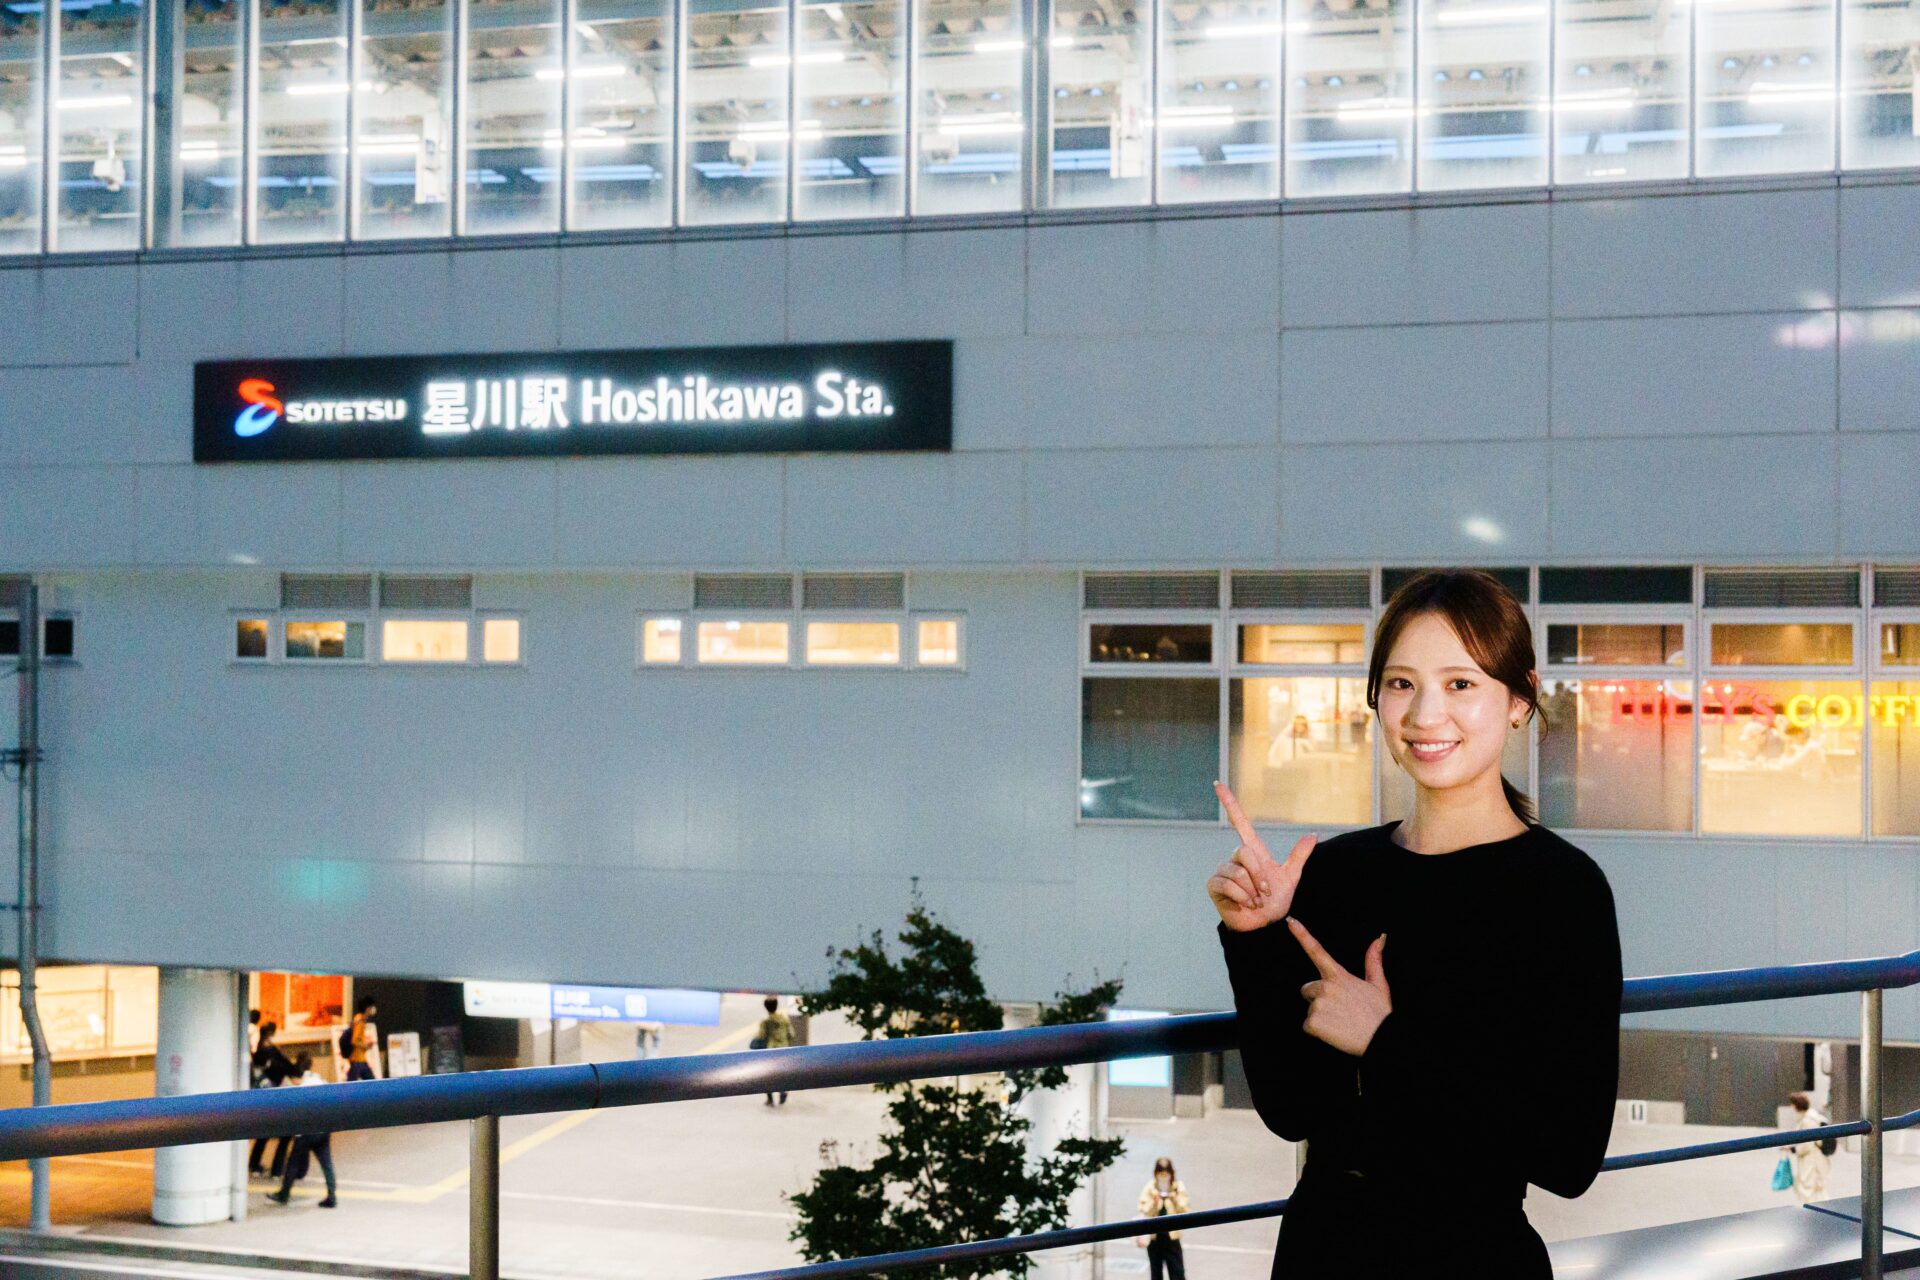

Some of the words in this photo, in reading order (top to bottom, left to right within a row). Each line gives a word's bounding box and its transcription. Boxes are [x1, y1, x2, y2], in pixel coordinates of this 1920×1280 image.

[285, 399, 406, 424] SOTETSU
[421, 377, 569, 435] 星川駅
[581, 376, 803, 424] Hoshikawa
[815, 371, 895, 418] Sta.
